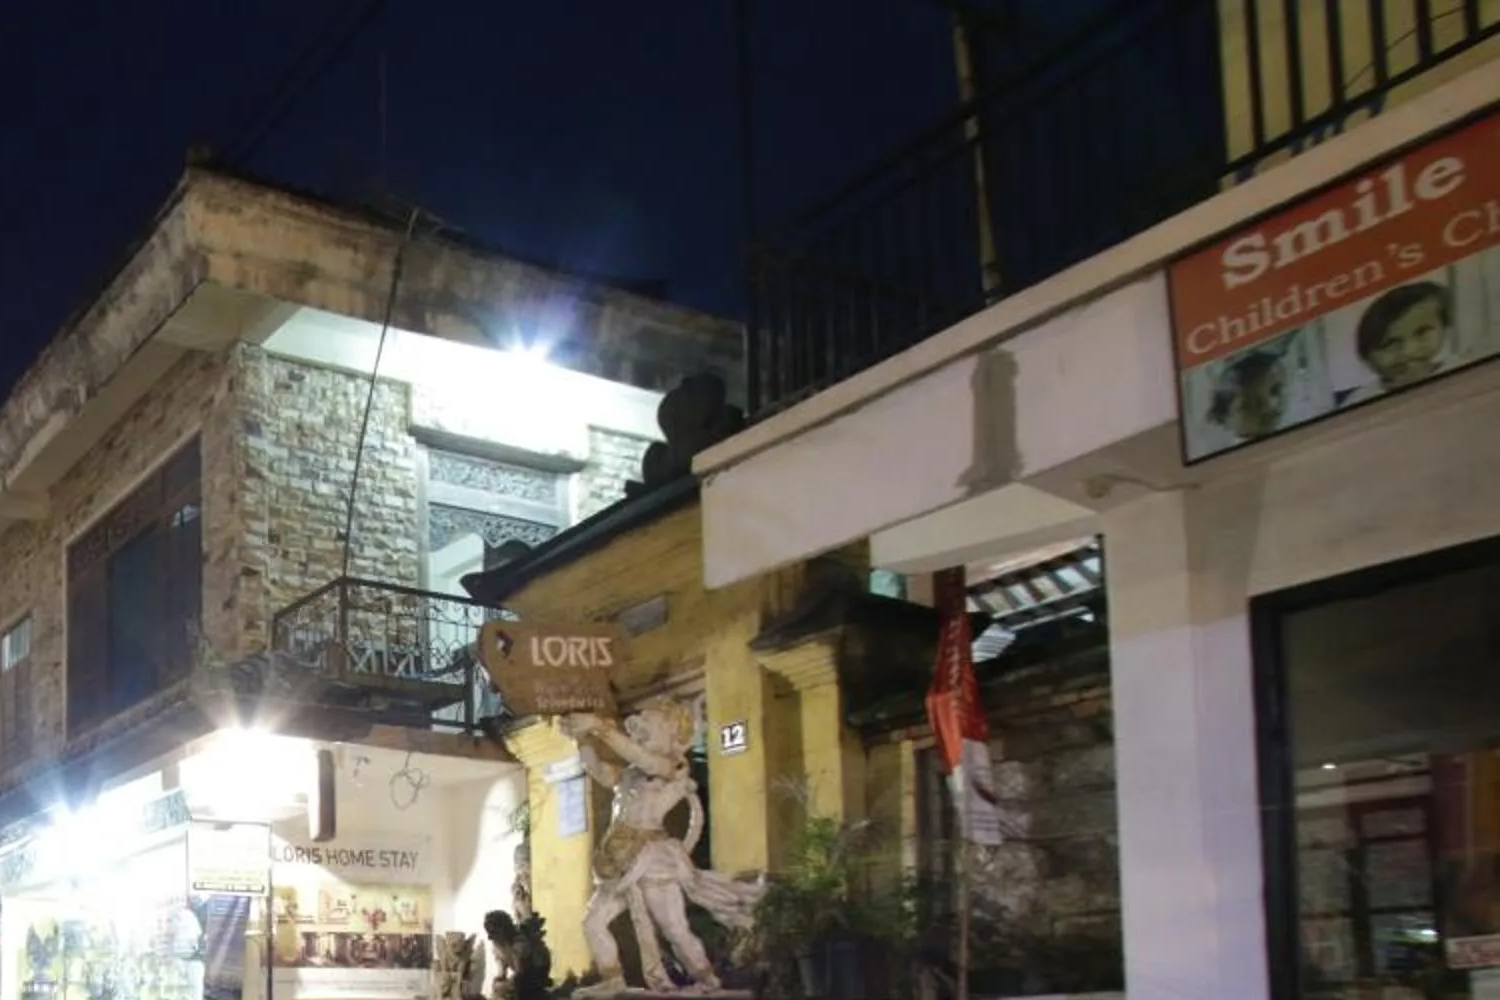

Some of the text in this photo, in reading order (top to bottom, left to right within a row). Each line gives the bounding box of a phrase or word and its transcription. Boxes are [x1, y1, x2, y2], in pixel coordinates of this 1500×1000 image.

[1221, 157, 1466, 290] Smile
[1186, 242, 1424, 355] Children's
[531, 636, 613, 669] LORIS
[722, 724, 746, 748] 12
[273, 845, 419, 870] LORIS HOME STAY
